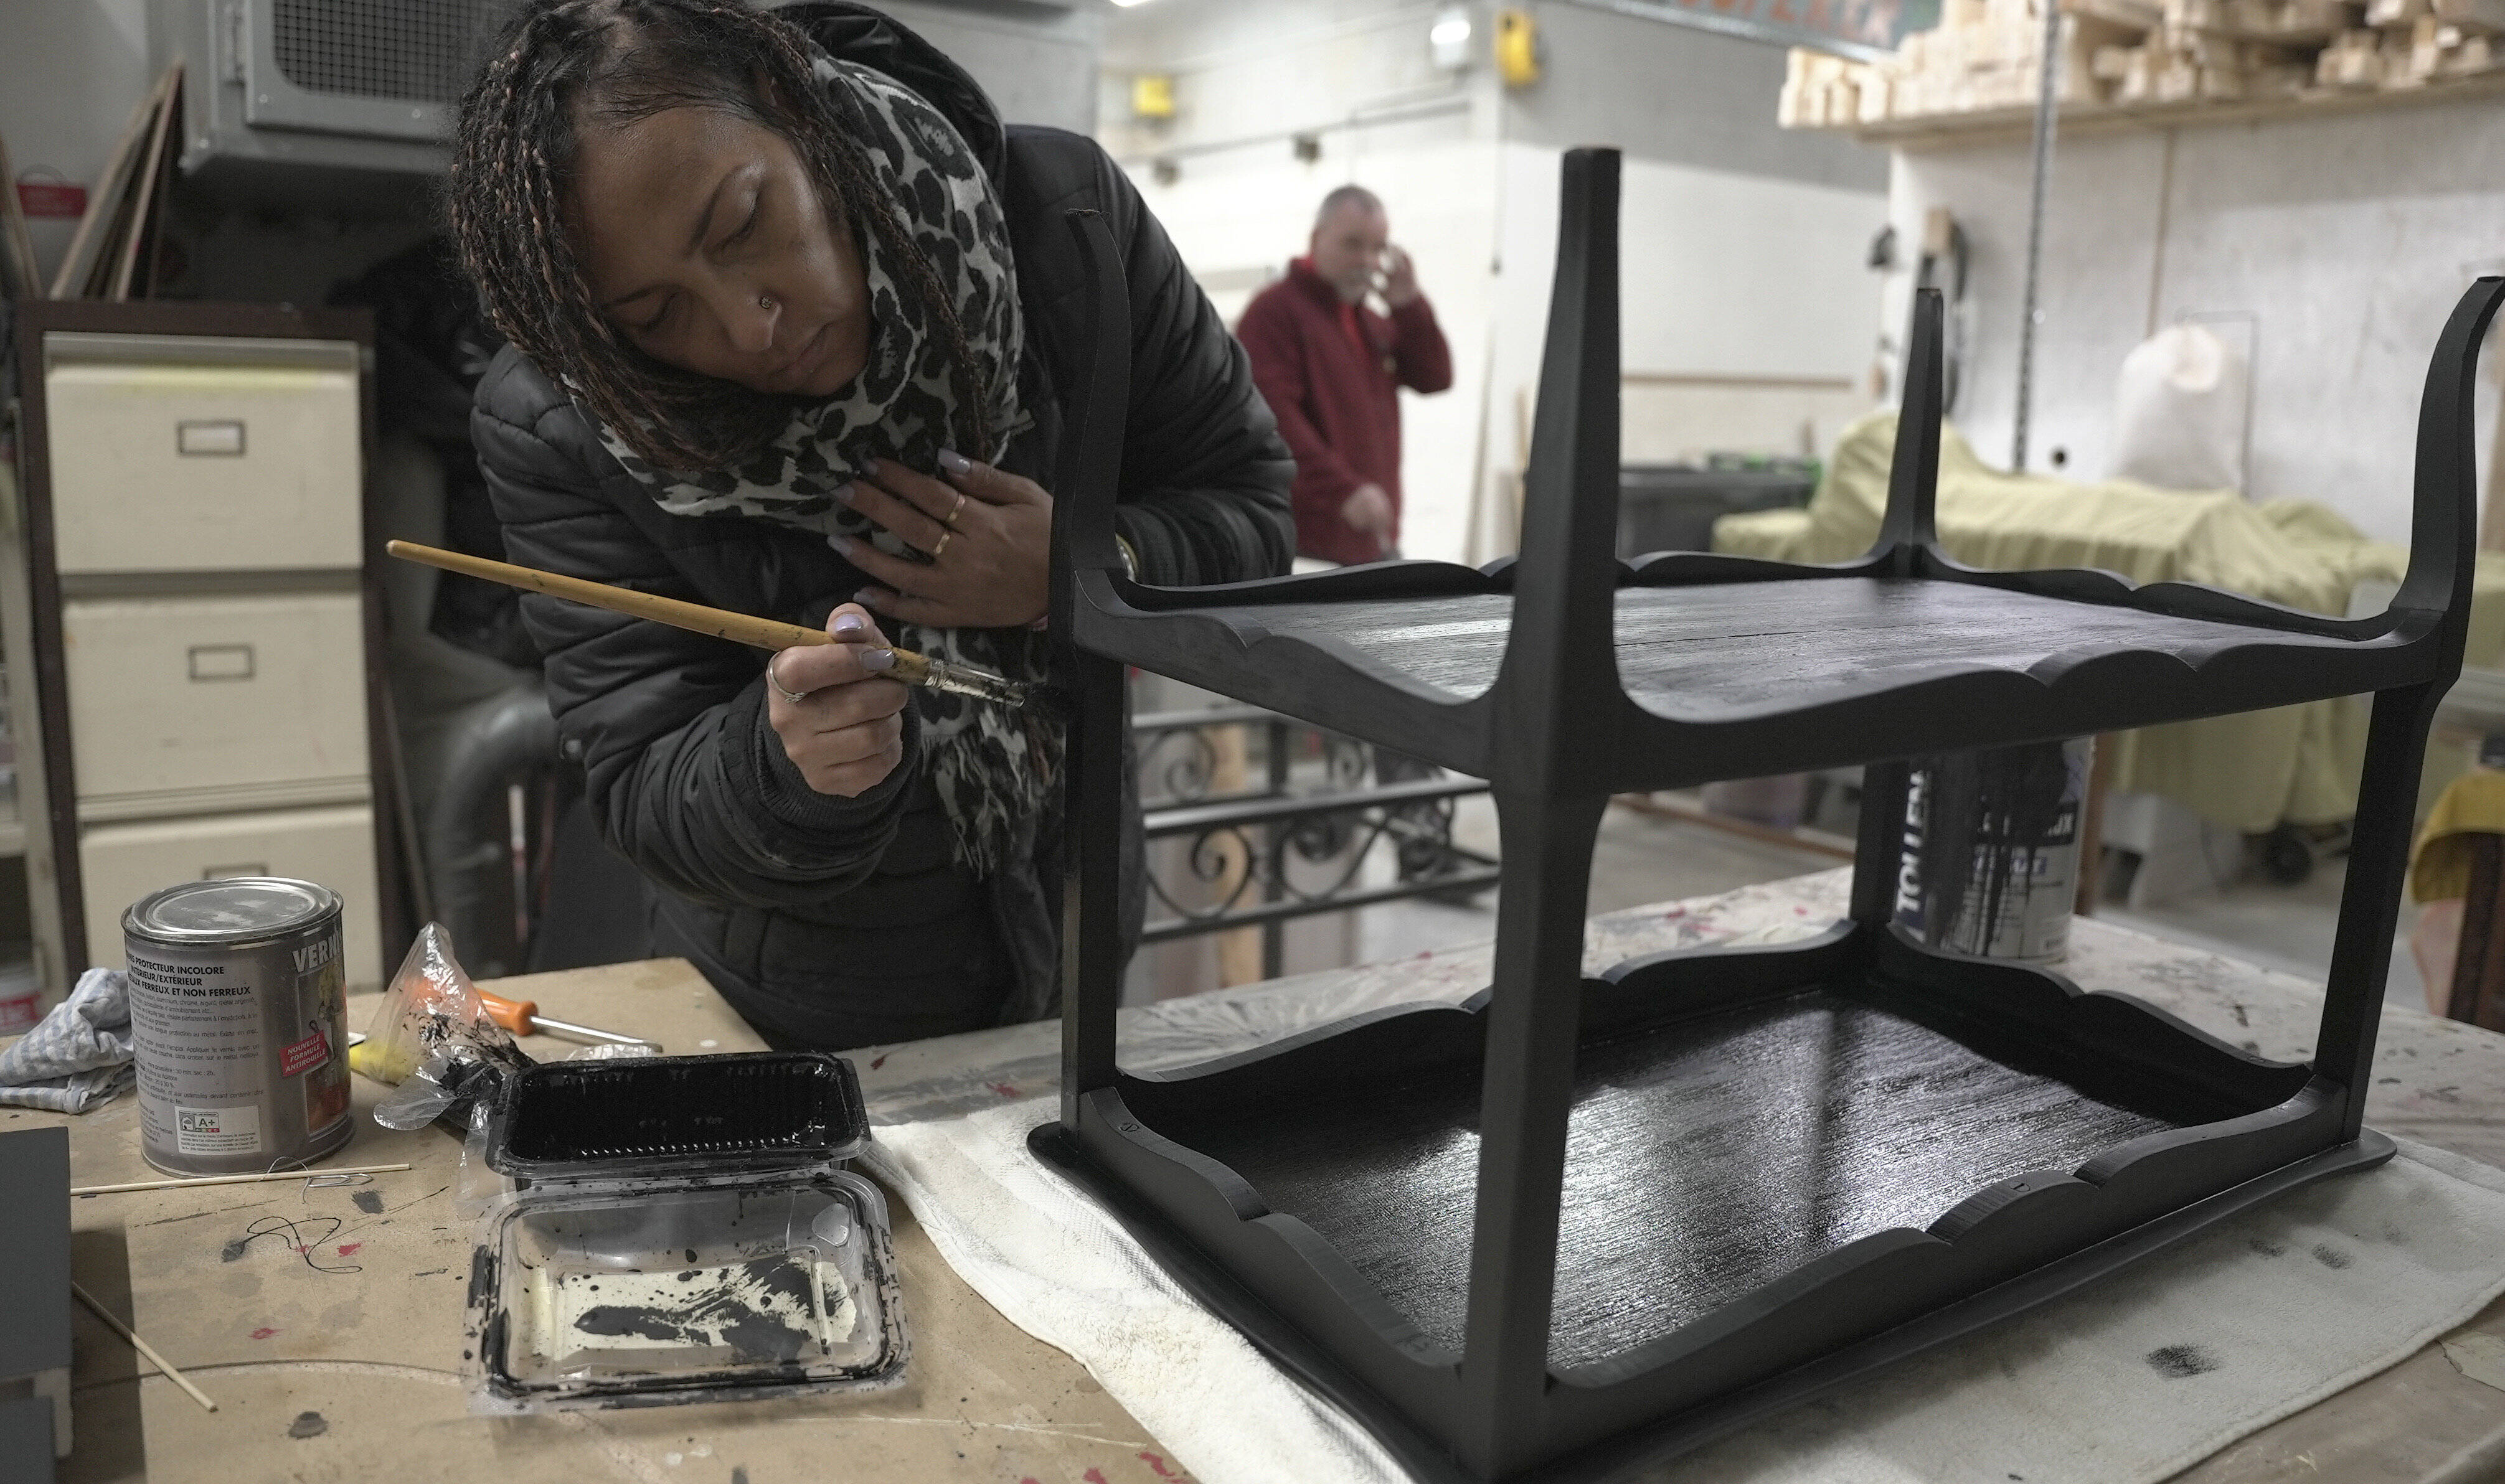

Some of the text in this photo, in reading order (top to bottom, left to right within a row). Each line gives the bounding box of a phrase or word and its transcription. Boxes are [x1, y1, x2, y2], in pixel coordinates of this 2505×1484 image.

[135, 957, 175, 974] PROTECTEUR
[177, 966, 224, 975] INCOLORE
[142, 980, 170, 995] FERREUX
[172, 988, 181, 996] ET
[183, 989, 206, 997] NON
[209, 986, 251, 997] FERREUX
[287, 1035, 320, 1055] NOUVELLE
[290, 1043, 320, 1063] FORMULE
[285, 1048, 326, 1073] ANTIROUILLE
[199, 1118, 215, 1127] A+
